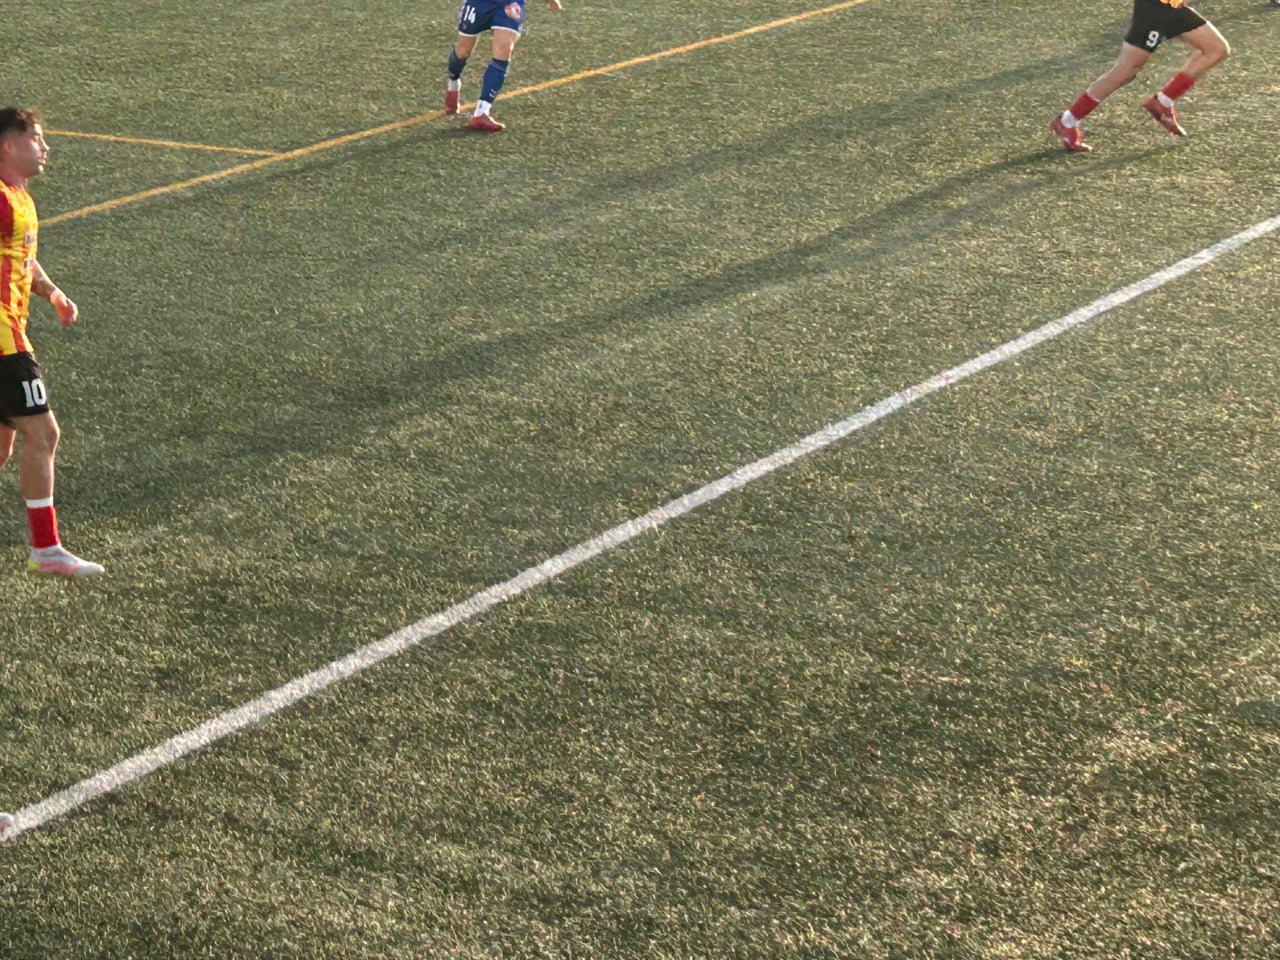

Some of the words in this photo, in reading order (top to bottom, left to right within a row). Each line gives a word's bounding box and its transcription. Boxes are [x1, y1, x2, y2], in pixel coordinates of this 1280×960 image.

[463, 5, 477, 24] 14
[1146, 30, 1160, 48] 9
[22, 378, 47, 408] 10
